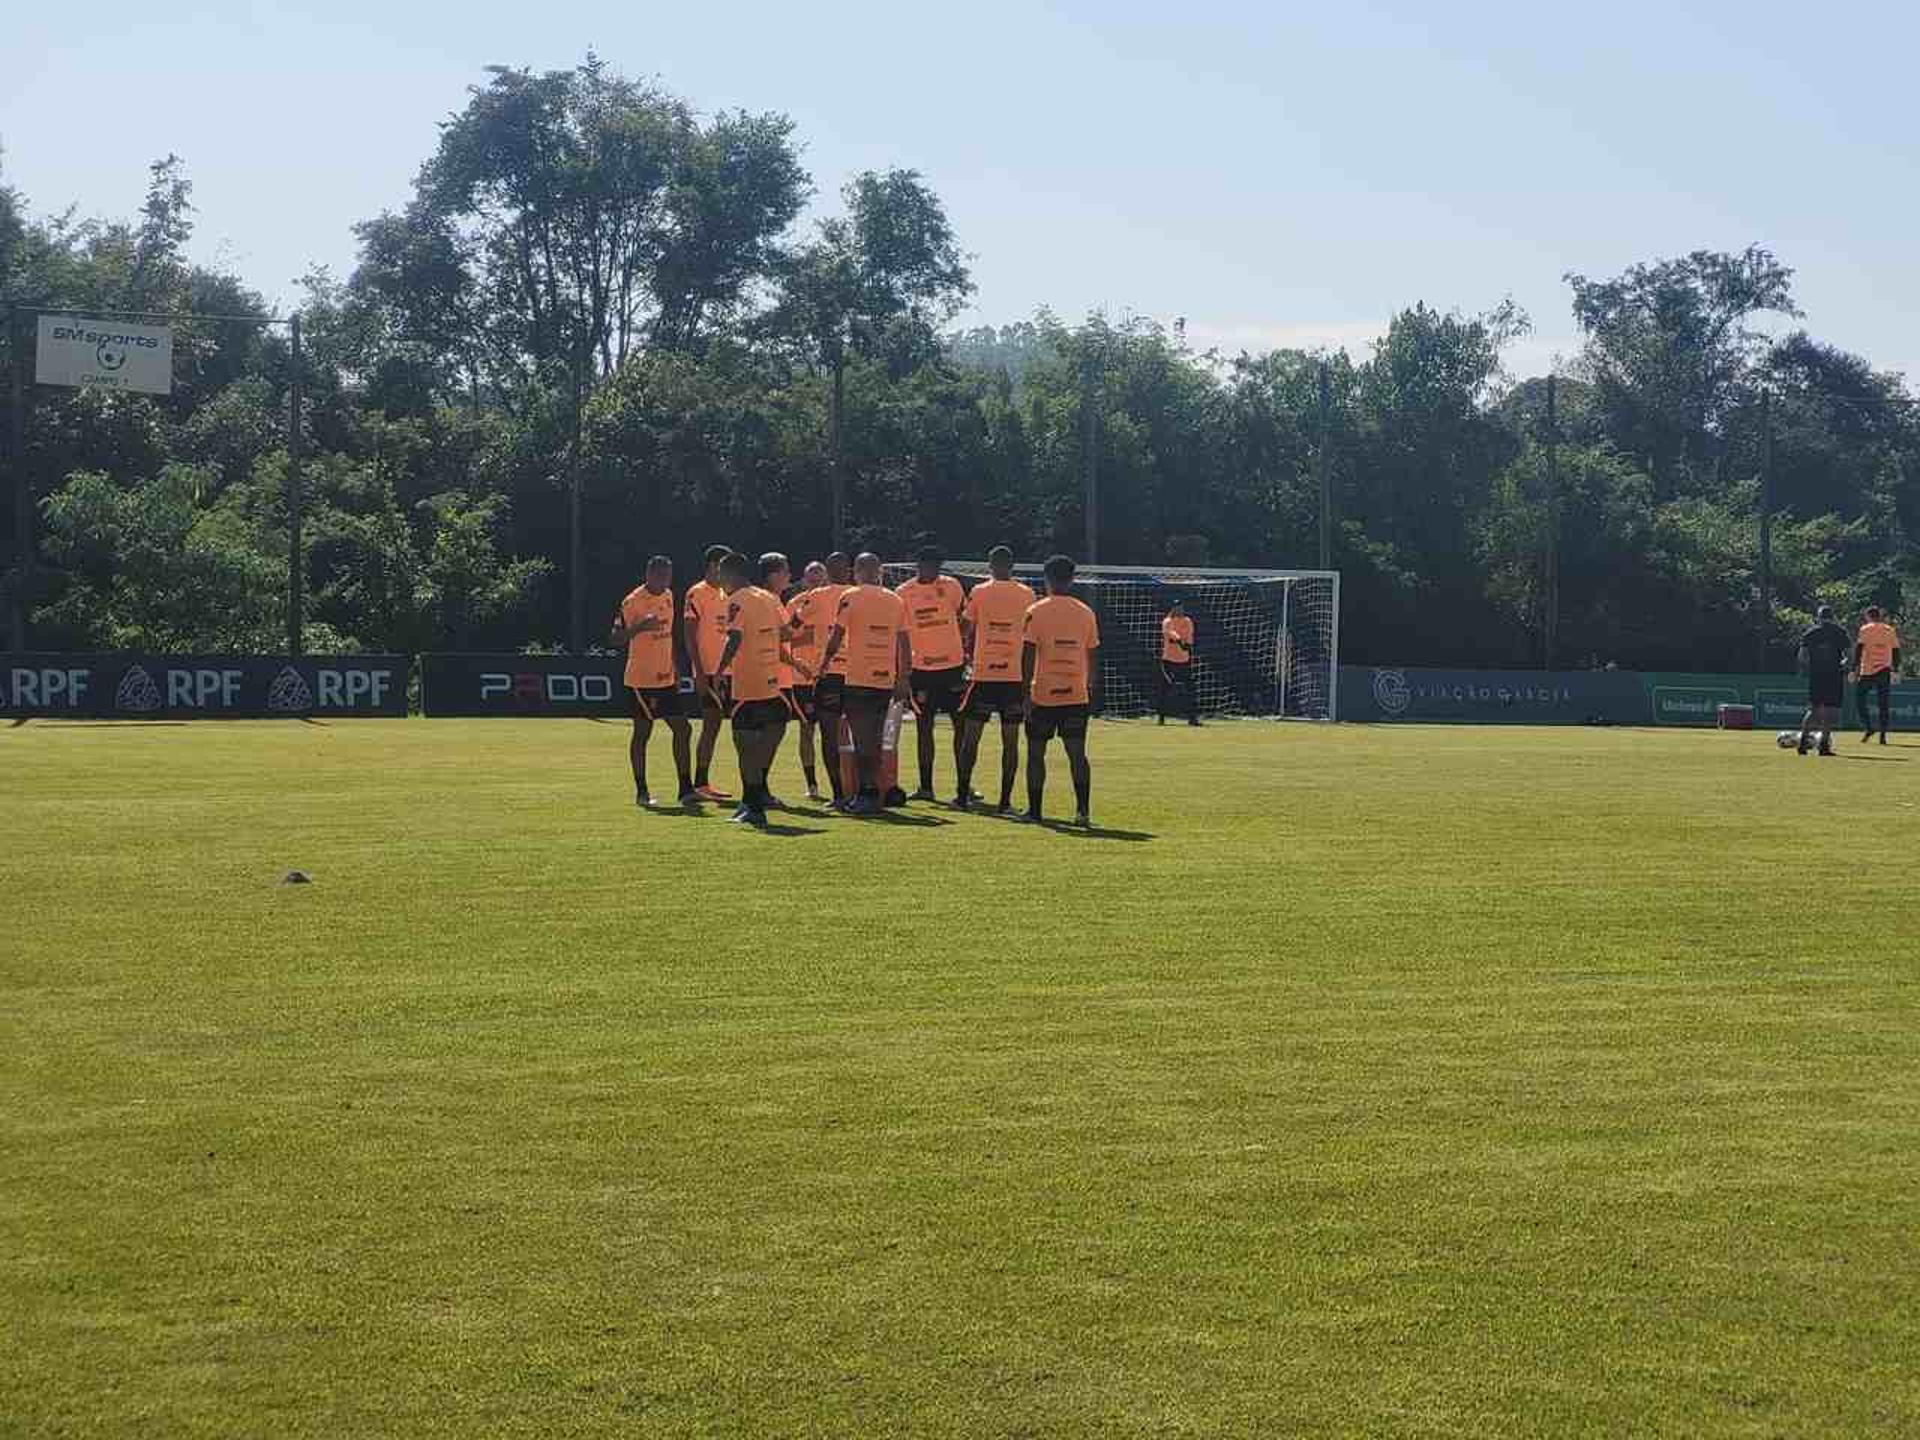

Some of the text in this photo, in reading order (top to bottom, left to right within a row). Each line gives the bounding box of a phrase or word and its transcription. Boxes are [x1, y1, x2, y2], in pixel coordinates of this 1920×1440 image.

[11, 668, 90, 707] RPF
[167, 669, 244, 708] RPF
[317, 669, 392, 708] RPF
